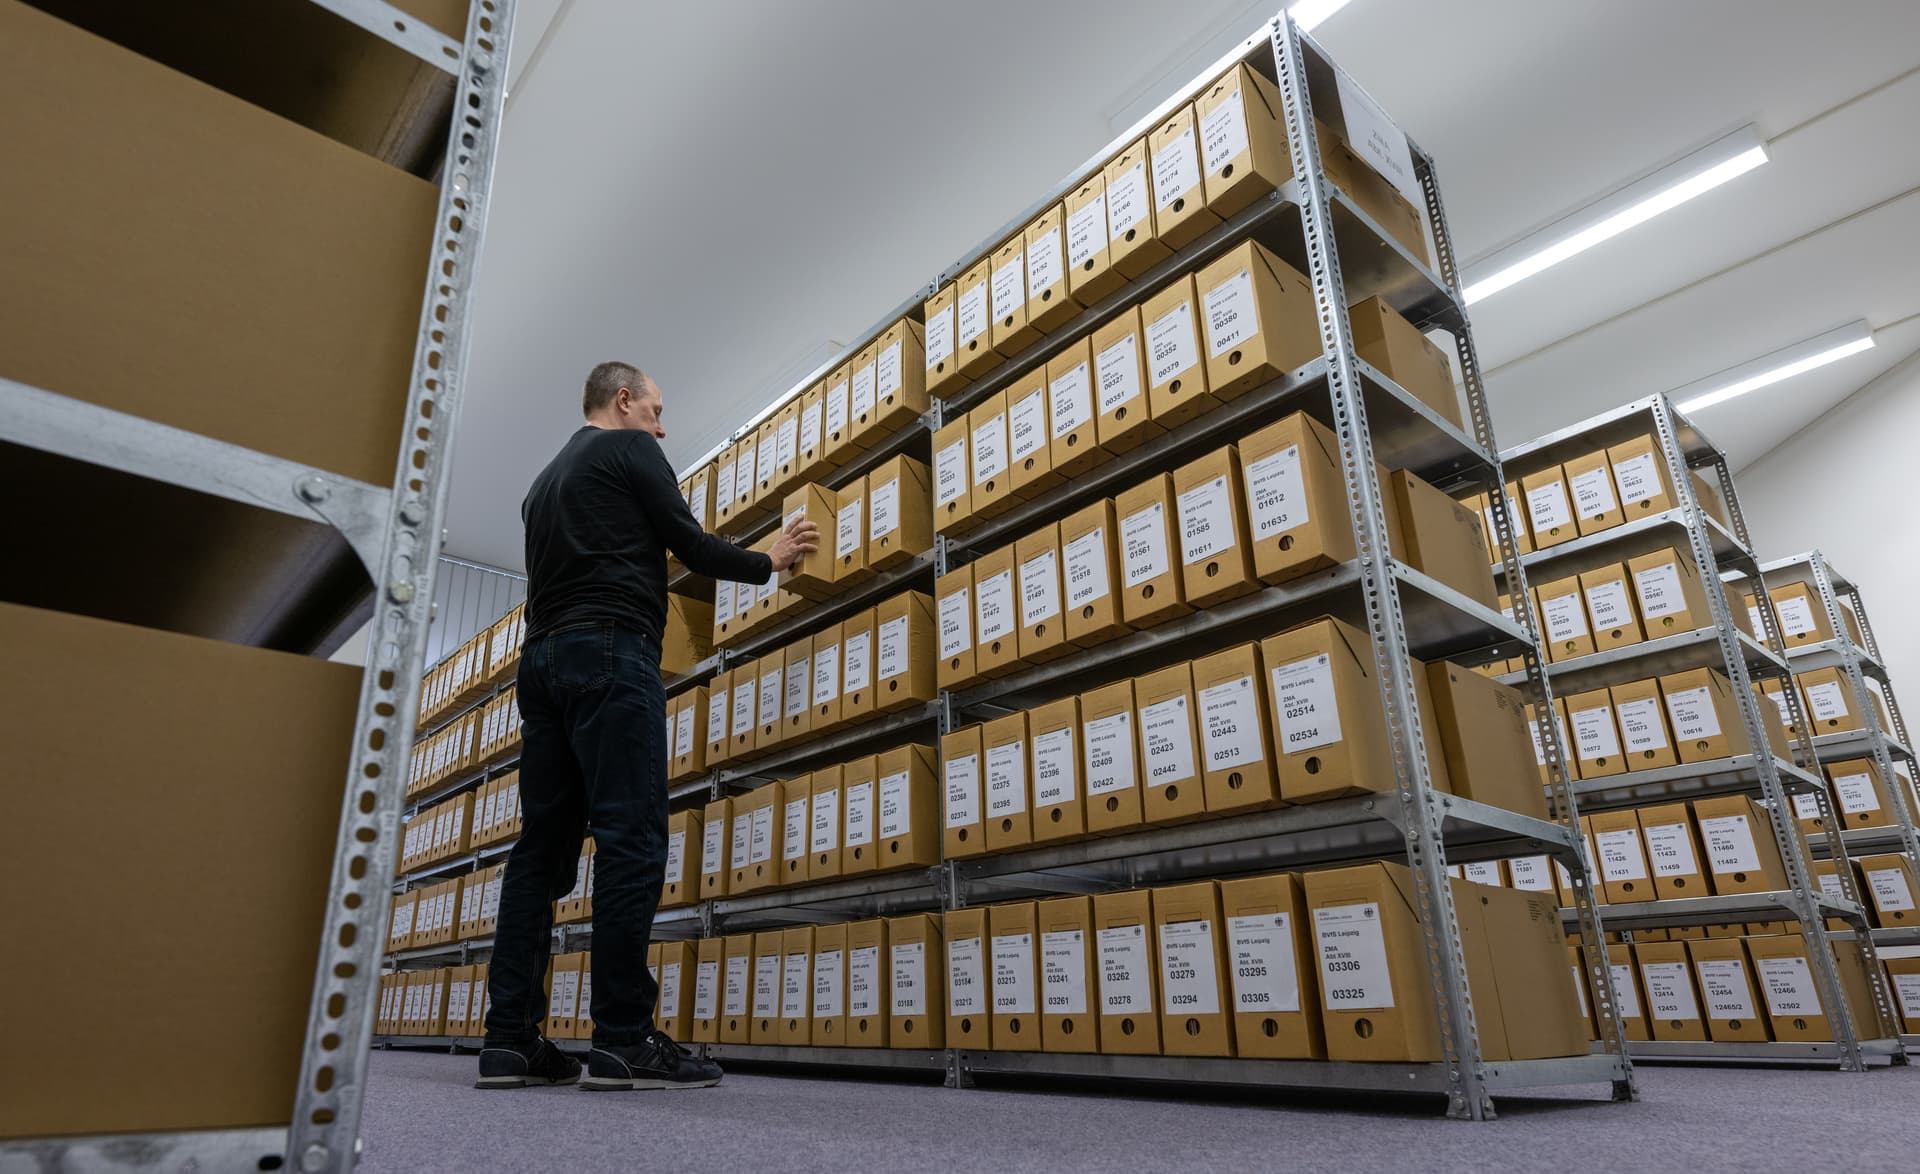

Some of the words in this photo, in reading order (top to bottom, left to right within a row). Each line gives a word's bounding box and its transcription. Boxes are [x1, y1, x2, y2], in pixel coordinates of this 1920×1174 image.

[1215, 312, 1237, 330] 00380
[1217, 330, 1239, 348] 00411
[1156, 344, 1176, 360] 00352
[1159, 361, 1179, 378] 00379
[1104, 374, 1123, 390] 00327
[1106, 391, 1124, 406] 00351
[1258, 494, 1285, 509] 01612
[1261, 514, 1287, 530] 01633
[1187, 523, 1210, 538] 01585
[1130, 546, 1150, 559] 01561
[1189, 543, 1212, 557] 01611
[1072, 569, 1090, 582] 01518
[1132, 564, 1152, 578] 01584
[1027, 589, 1045, 601] 01491
[1074, 587, 1092, 600] 01560
[1645, 591, 1663, 600] 09567
[983, 607, 1000, 619] 01472
[1029, 606, 1046, 618] 01517
[1295, 678, 1314, 688] Leipzig
[1287, 705, 1315, 719] 02514
[1212, 725, 1237, 738] 02443
[1290, 728, 1318, 742] 02534
[1151, 743, 1174, 755] 02423
[1214, 748, 1240, 761] 02513
[1092, 757, 1112, 768] 02409
[1041, 768, 1059, 779] 02396
[1153, 764, 1176, 776] 02442
[993, 780, 1010, 790] 02375
[1093, 777, 1114, 788] 02422
[1041, 788, 1060, 798] 02408
[993, 800, 1010, 809] 02395
[951, 811, 967, 820] 02374
[1239, 967, 1267, 977] 03295
[1329, 961, 1360, 972] 03306
[1048, 975, 1068, 983] 03241
[1107, 972, 1130, 982] 03262
[1170, 970, 1195, 979] 03279
[997, 977, 1016, 985] 03213
[1172, 995, 1197, 1004] 03294
[1242, 993, 1269, 1002] 03305
[1333, 989, 1364, 999] 03325
[955, 998, 972, 1006] 03212
[998, 998, 1016, 1006] 03240
[1048, 997, 1068, 1005] 03261
[1109, 996, 1131, 1005] 03278
